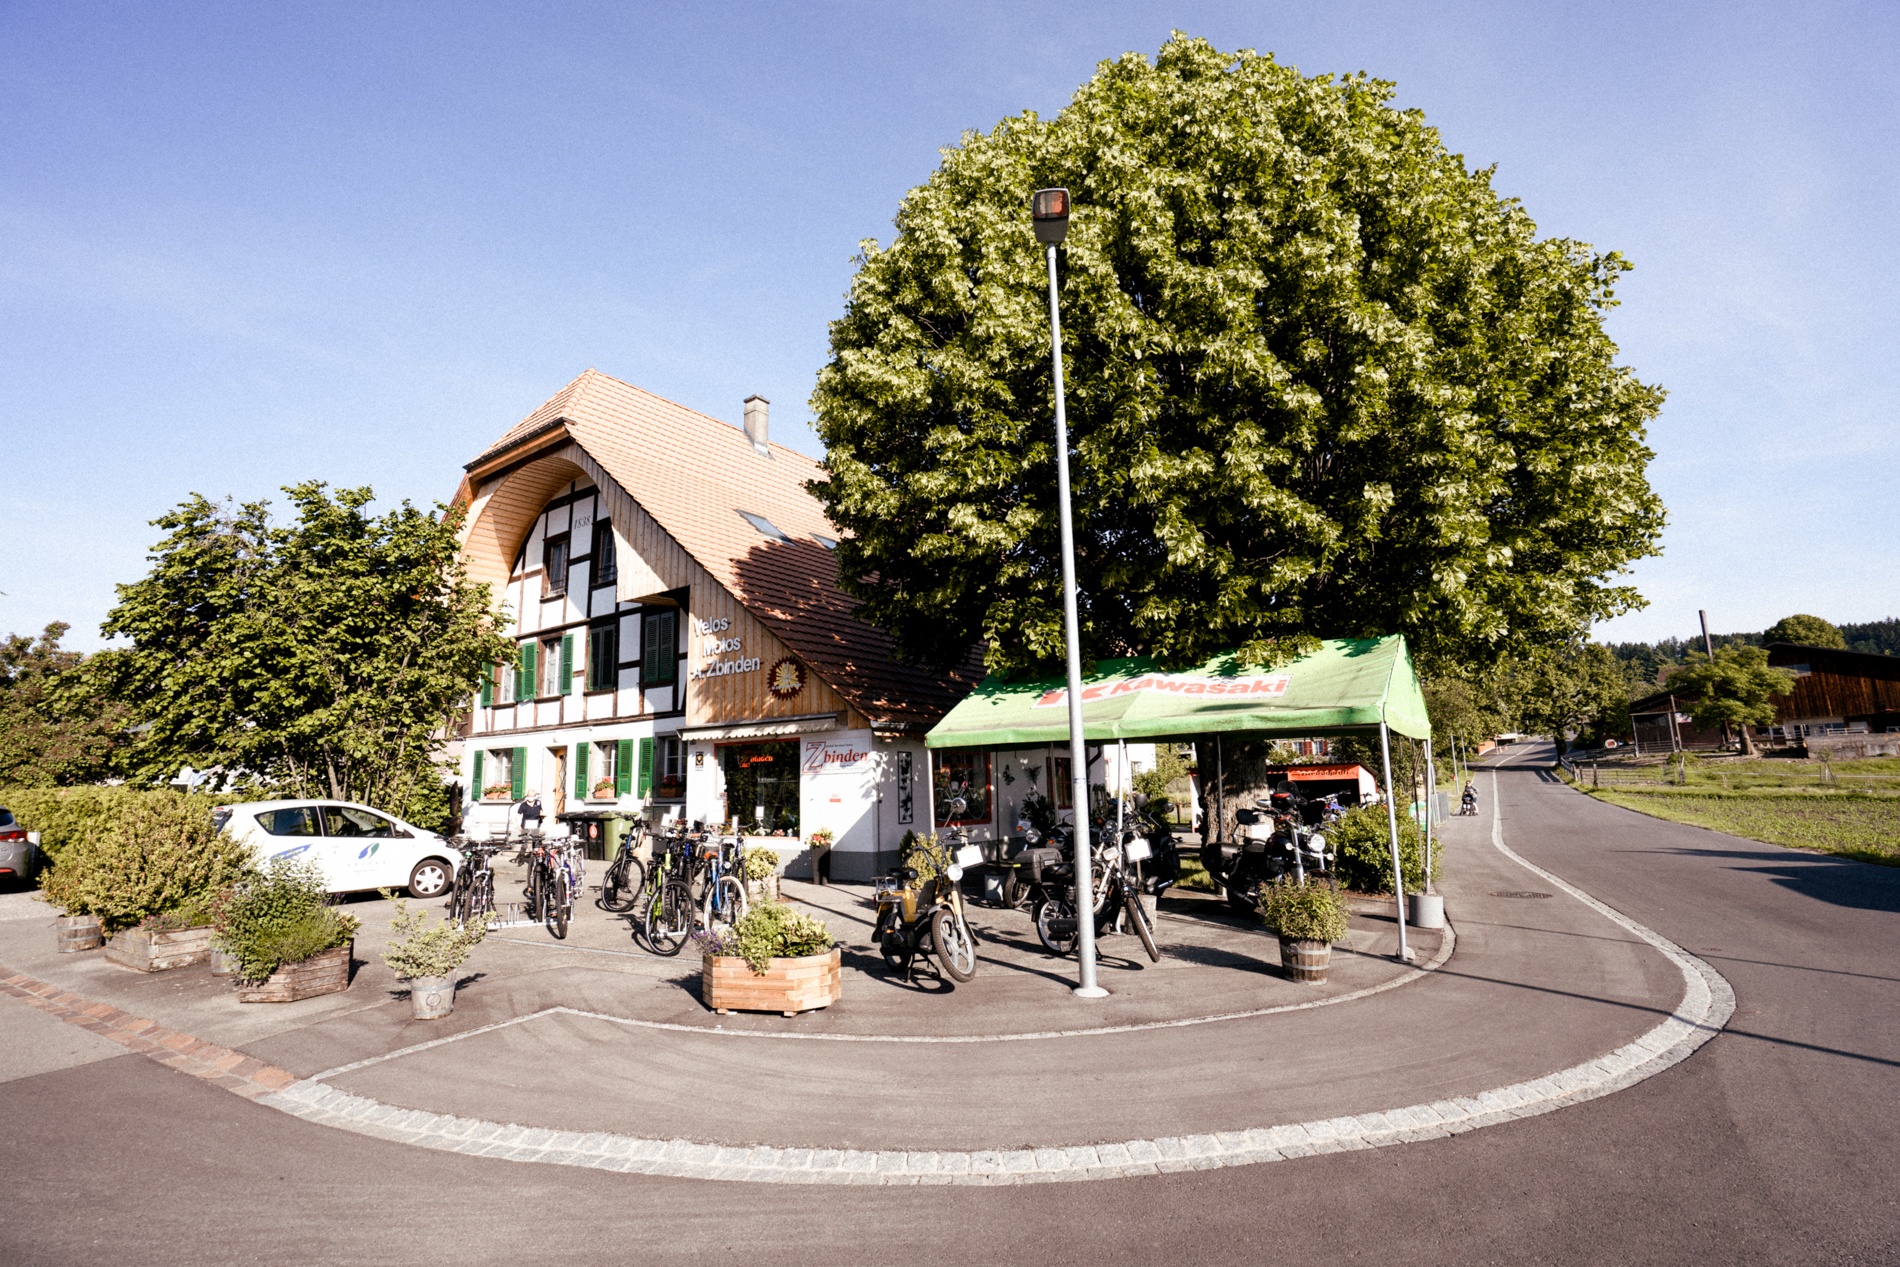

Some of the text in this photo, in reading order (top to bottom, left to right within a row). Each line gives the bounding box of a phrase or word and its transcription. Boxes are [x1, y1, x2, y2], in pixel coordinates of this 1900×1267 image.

[693, 617, 728, 636] Velos
[702, 637, 741, 657] Motos
[707, 656, 760, 677] Zbinden
[1109, 677, 1288, 696] Kawasaki
